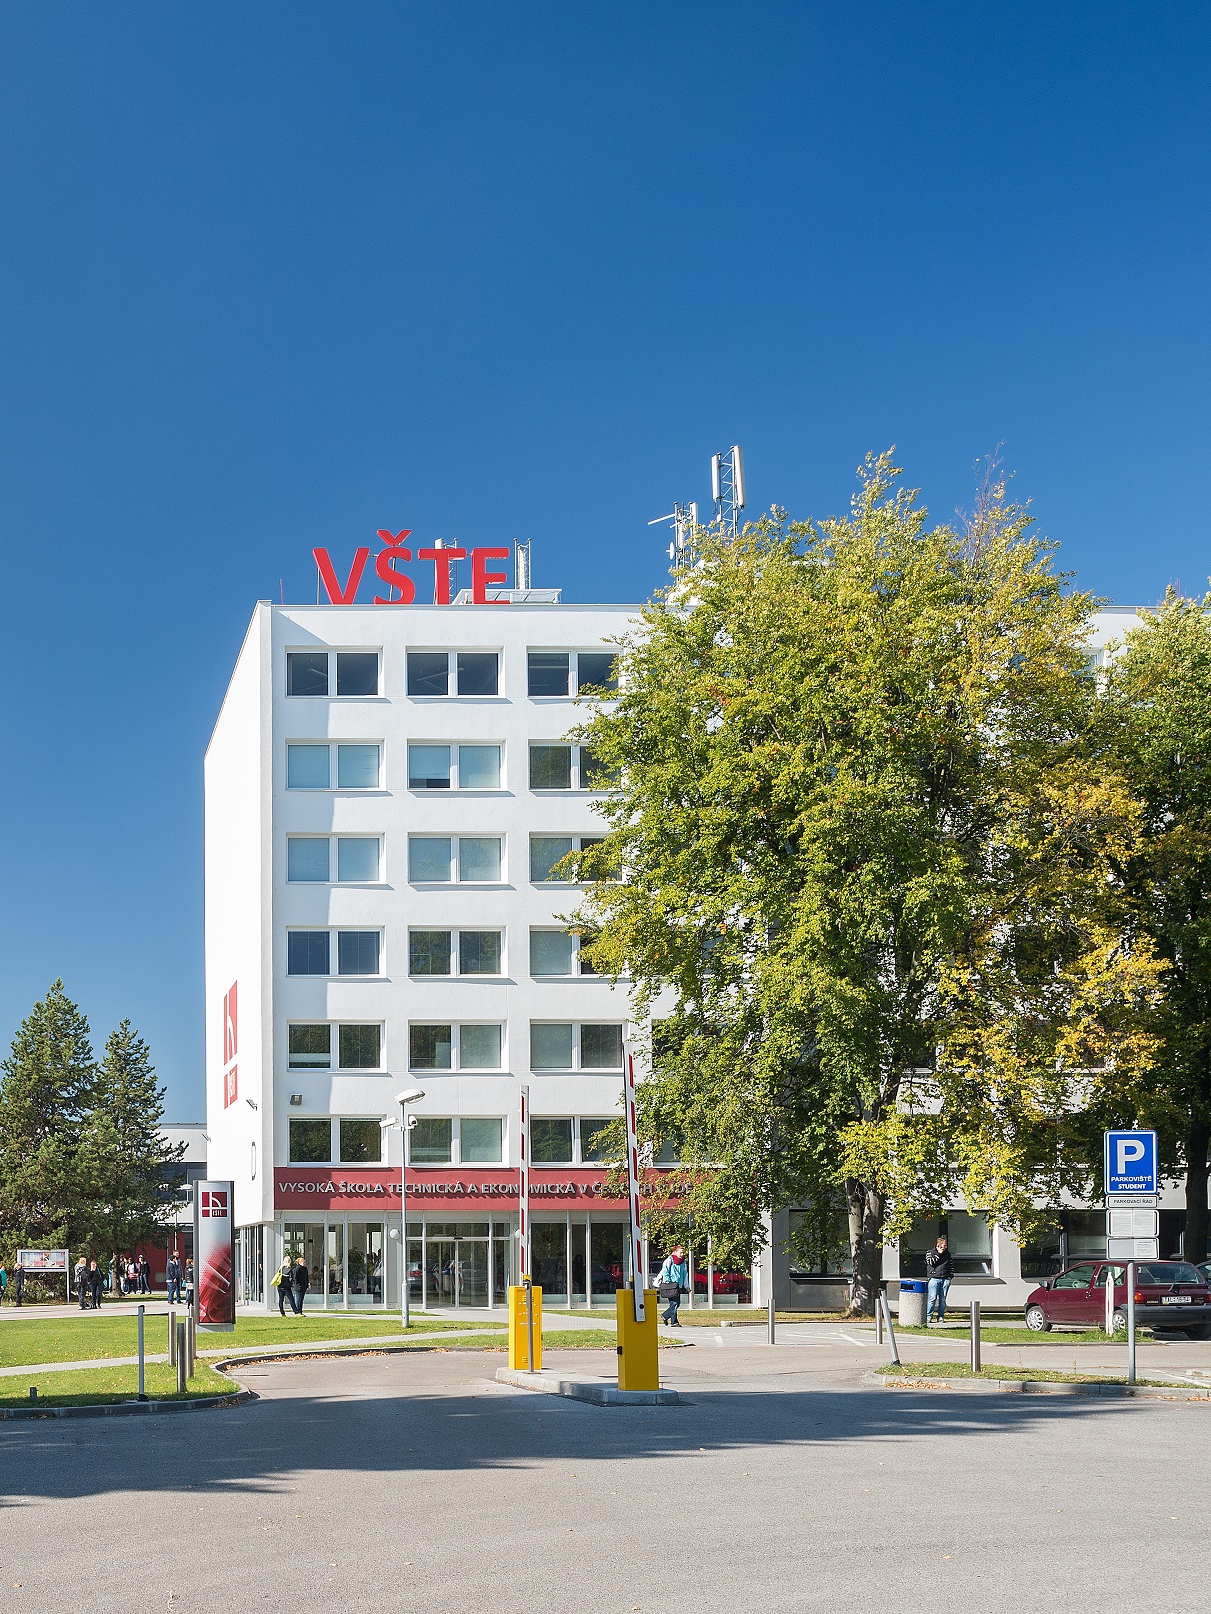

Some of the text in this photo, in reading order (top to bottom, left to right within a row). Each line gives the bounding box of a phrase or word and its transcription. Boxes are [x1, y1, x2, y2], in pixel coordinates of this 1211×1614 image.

[313, 529, 510, 605] VŠTE
[1116, 1140, 1145, 1174] P
[278, 1180, 335, 1193] VYSOKÁ
[338, 1180, 384, 1193] ŠKOLA
[388, 1180, 464, 1194] TECHNICKÁ
[467, 1183, 479, 1194] A
[481, 1181, 576, 1194] EKONMICKÁ
[578, 1183, 588, 1194] V
